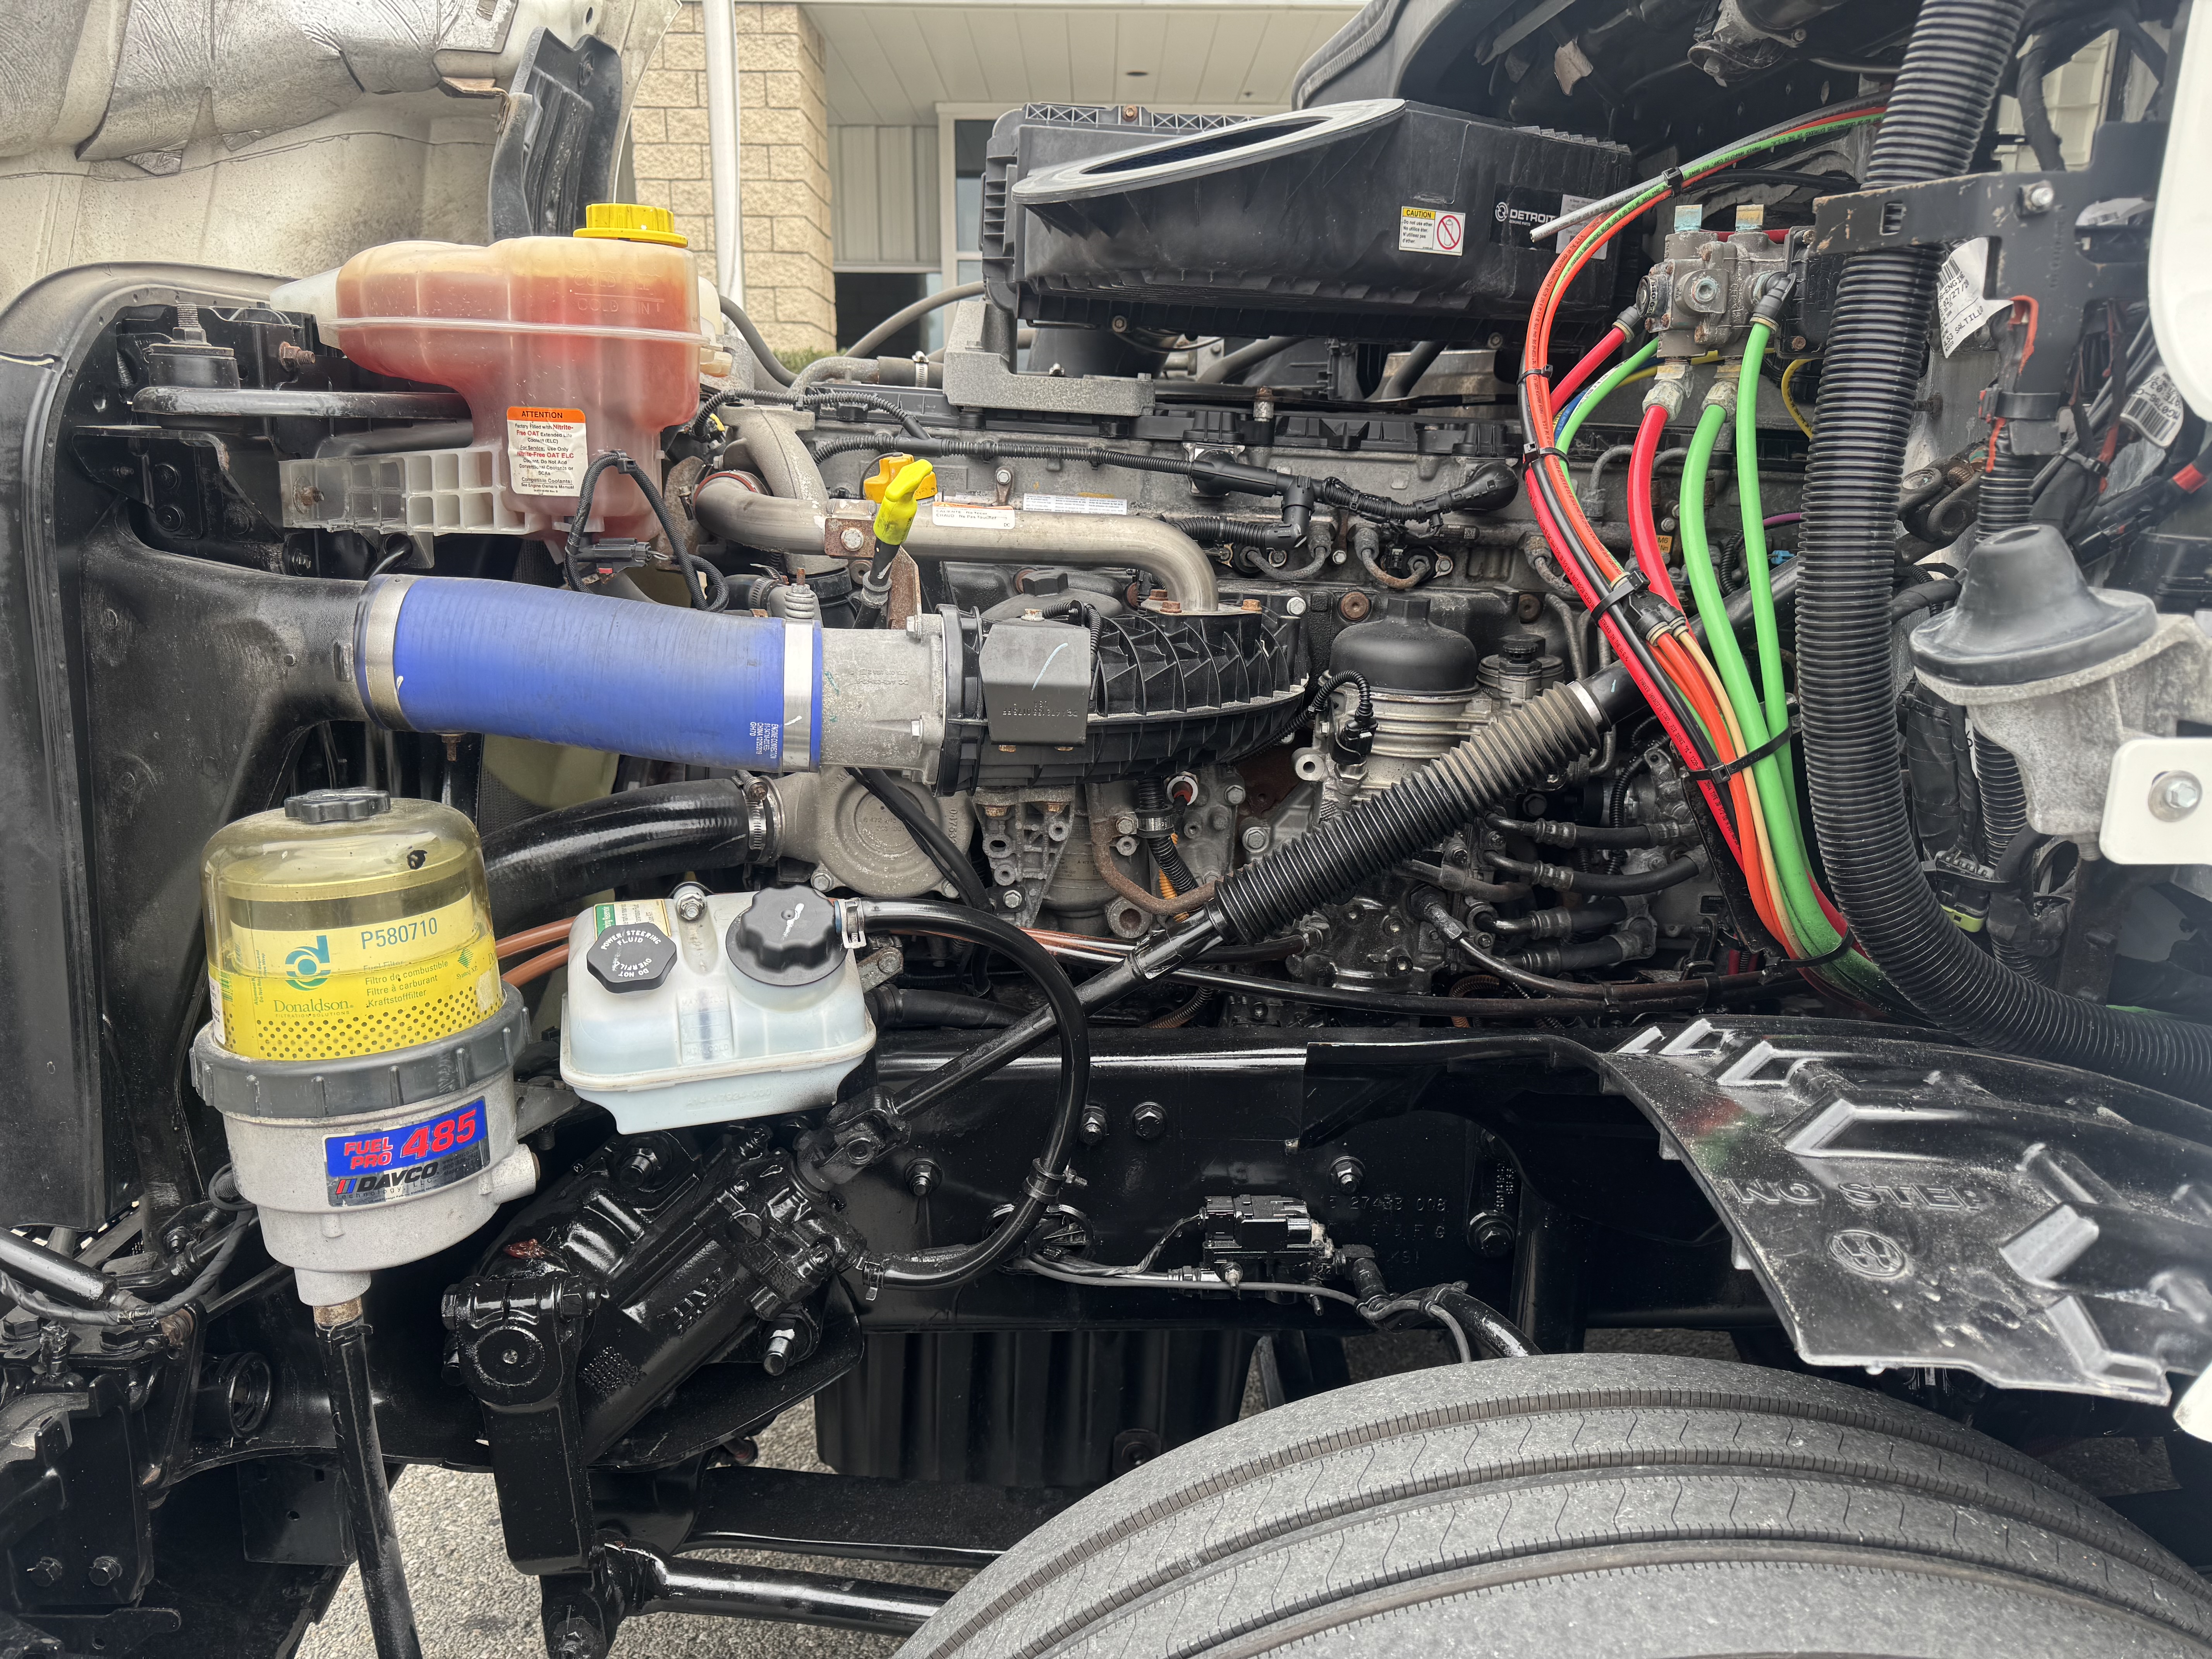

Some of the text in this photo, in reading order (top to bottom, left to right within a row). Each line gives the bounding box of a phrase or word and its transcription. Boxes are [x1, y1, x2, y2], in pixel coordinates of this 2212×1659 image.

[1407, 210, 1431, 218] CAUTION
[1510, 209, 1556, 223] DETROIT
[574, 275, 615, 287] COLD
[578, 299, 618, 312] COLD
[1955, 306, 1984, 333] SALTILLO
[361, 917, 438, 950] P580710
[601, 930, 661, 950] POWER STEERING
[617, 937, 643, 946] FLUID
[366, 977, 387, 985] Filtro
[400, 960, 449, 979] combustible
[367, 988, 388, 996] Filtre
[399, 975, 438, 990] carburant
[274, 998, 350, 1012] Donaldson
[369, 990, 426, 1007] Kraftstofffilter
[344, 1108, 477, 1159] FUEL 485
[350, 1151, 392, 1170] PRO
[357, 1162, 439, 1192] DAVCO
[1729, 1179, 1987, 1211] NO STEP
